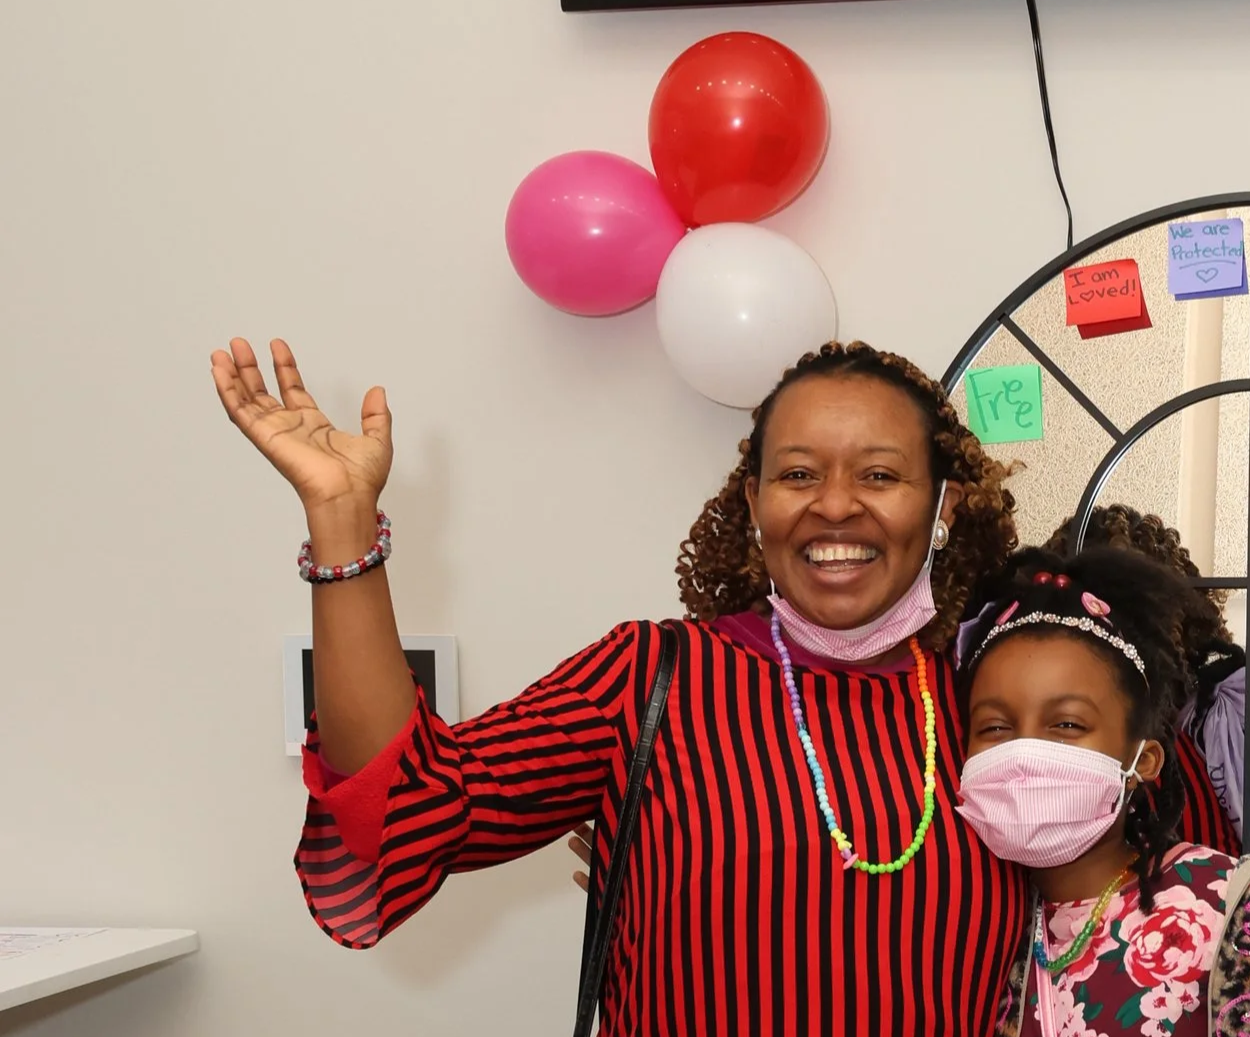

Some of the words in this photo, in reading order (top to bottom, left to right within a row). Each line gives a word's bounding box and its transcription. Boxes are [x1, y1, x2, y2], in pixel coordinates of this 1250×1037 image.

[1169, 224, 1194, 240] We
[1202, 221, 1229, 238] are
[1171, 240, 1244, 261] Protected
[1069, 271, 1085, 288] I
[1091, 267, 1120, 284] am
[968, 368, 1033, 434] Free
